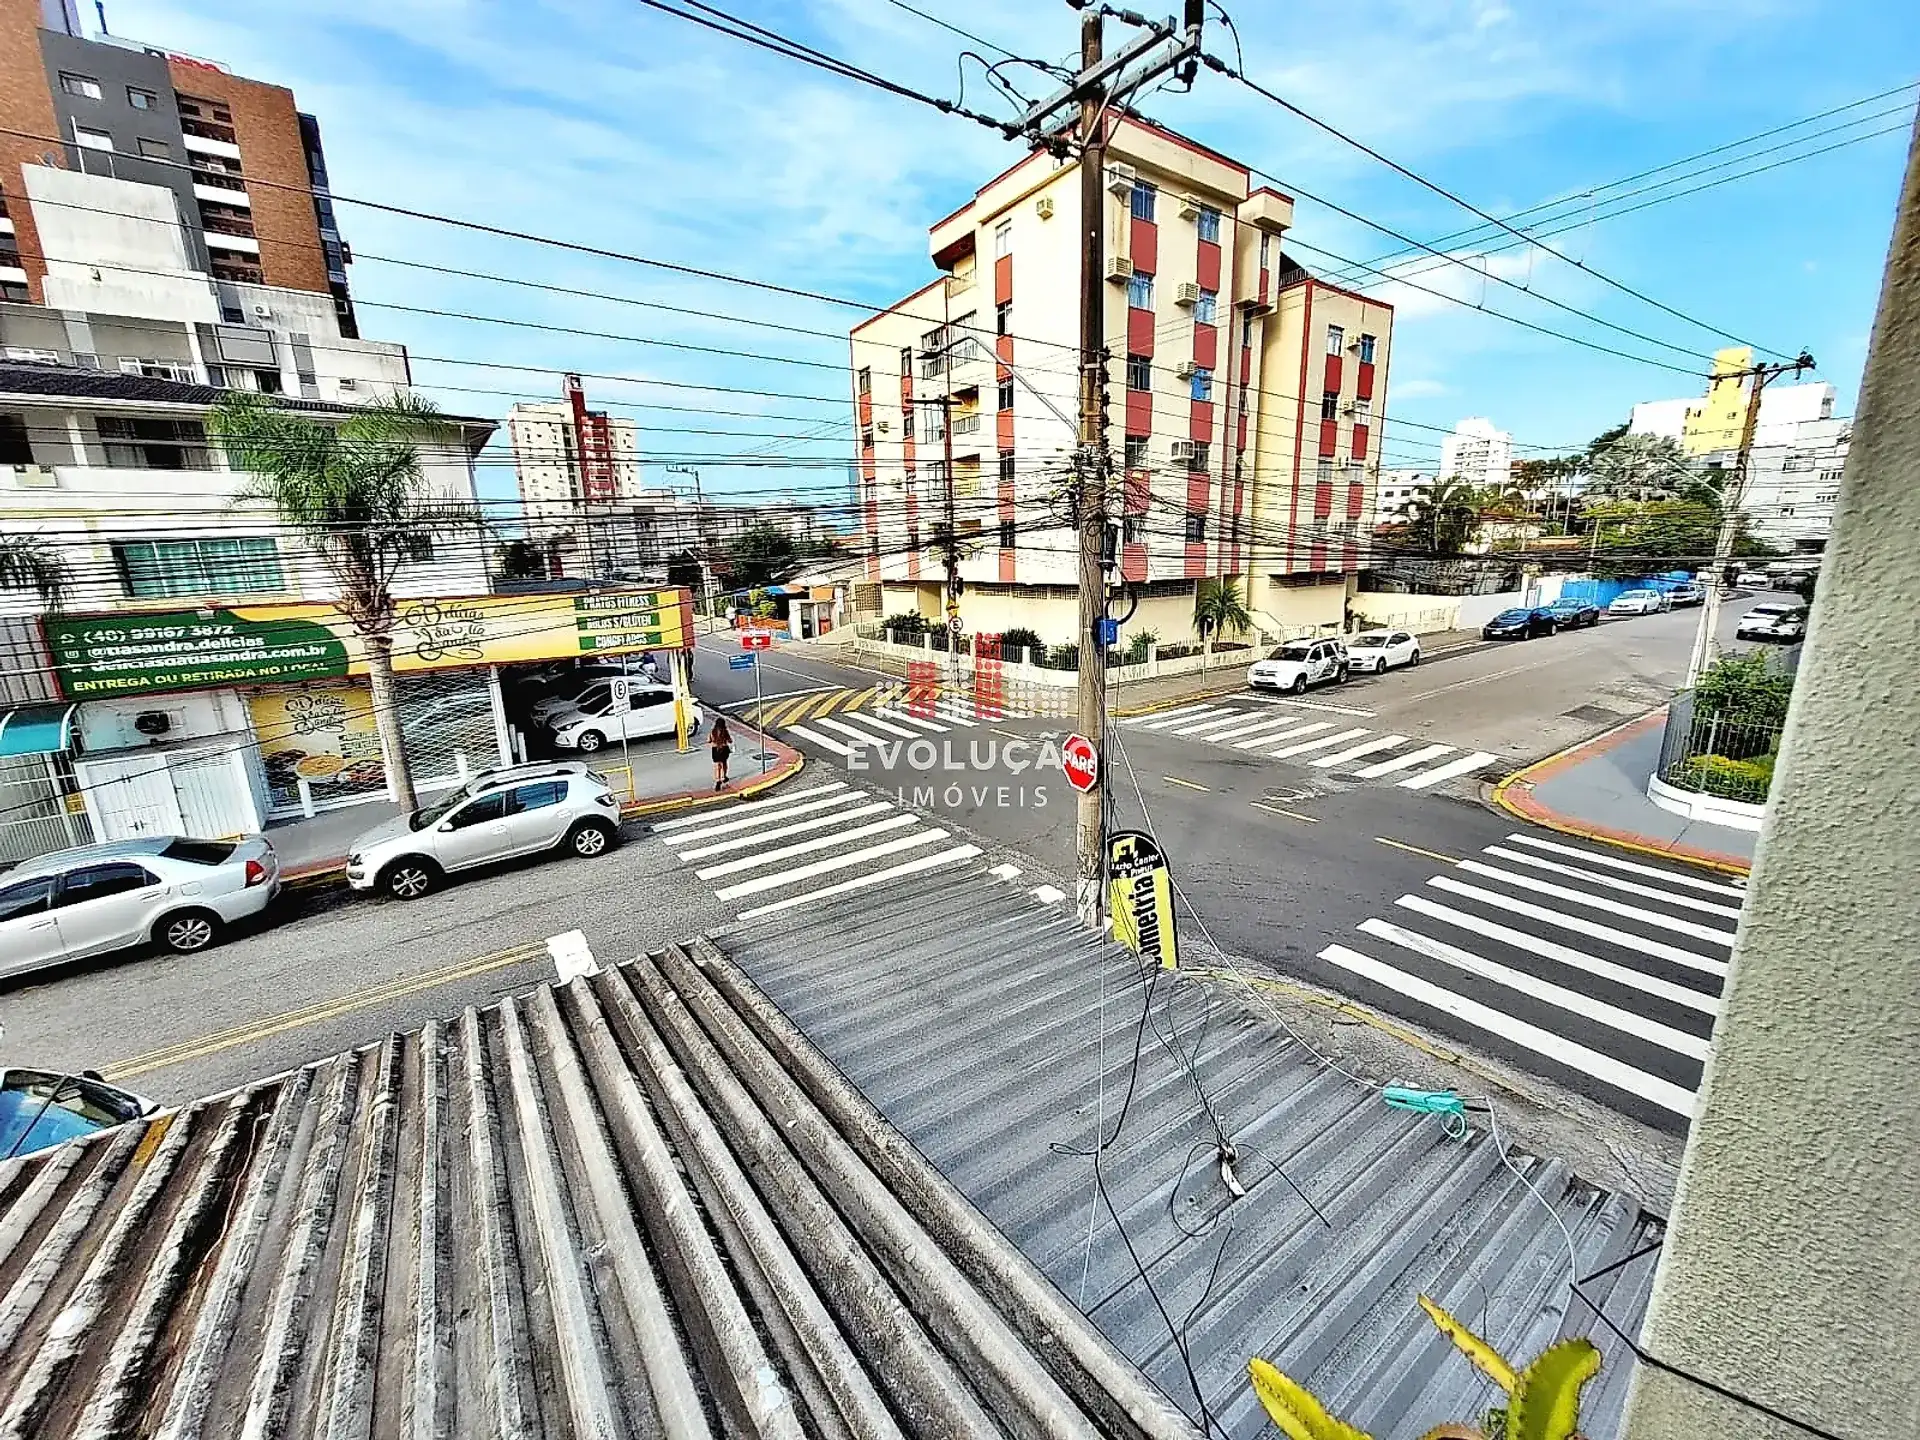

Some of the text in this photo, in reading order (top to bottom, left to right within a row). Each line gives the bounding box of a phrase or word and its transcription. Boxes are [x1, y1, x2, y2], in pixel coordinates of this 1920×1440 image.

[73, 676, 151, 692] ENTREGA
[154, 672, 178, 685] OU
[181, 667, 257, 683] RETIRADA
[1063, 751, 1096, 777] PARE
[1134, 853, 1160, 868] Center
